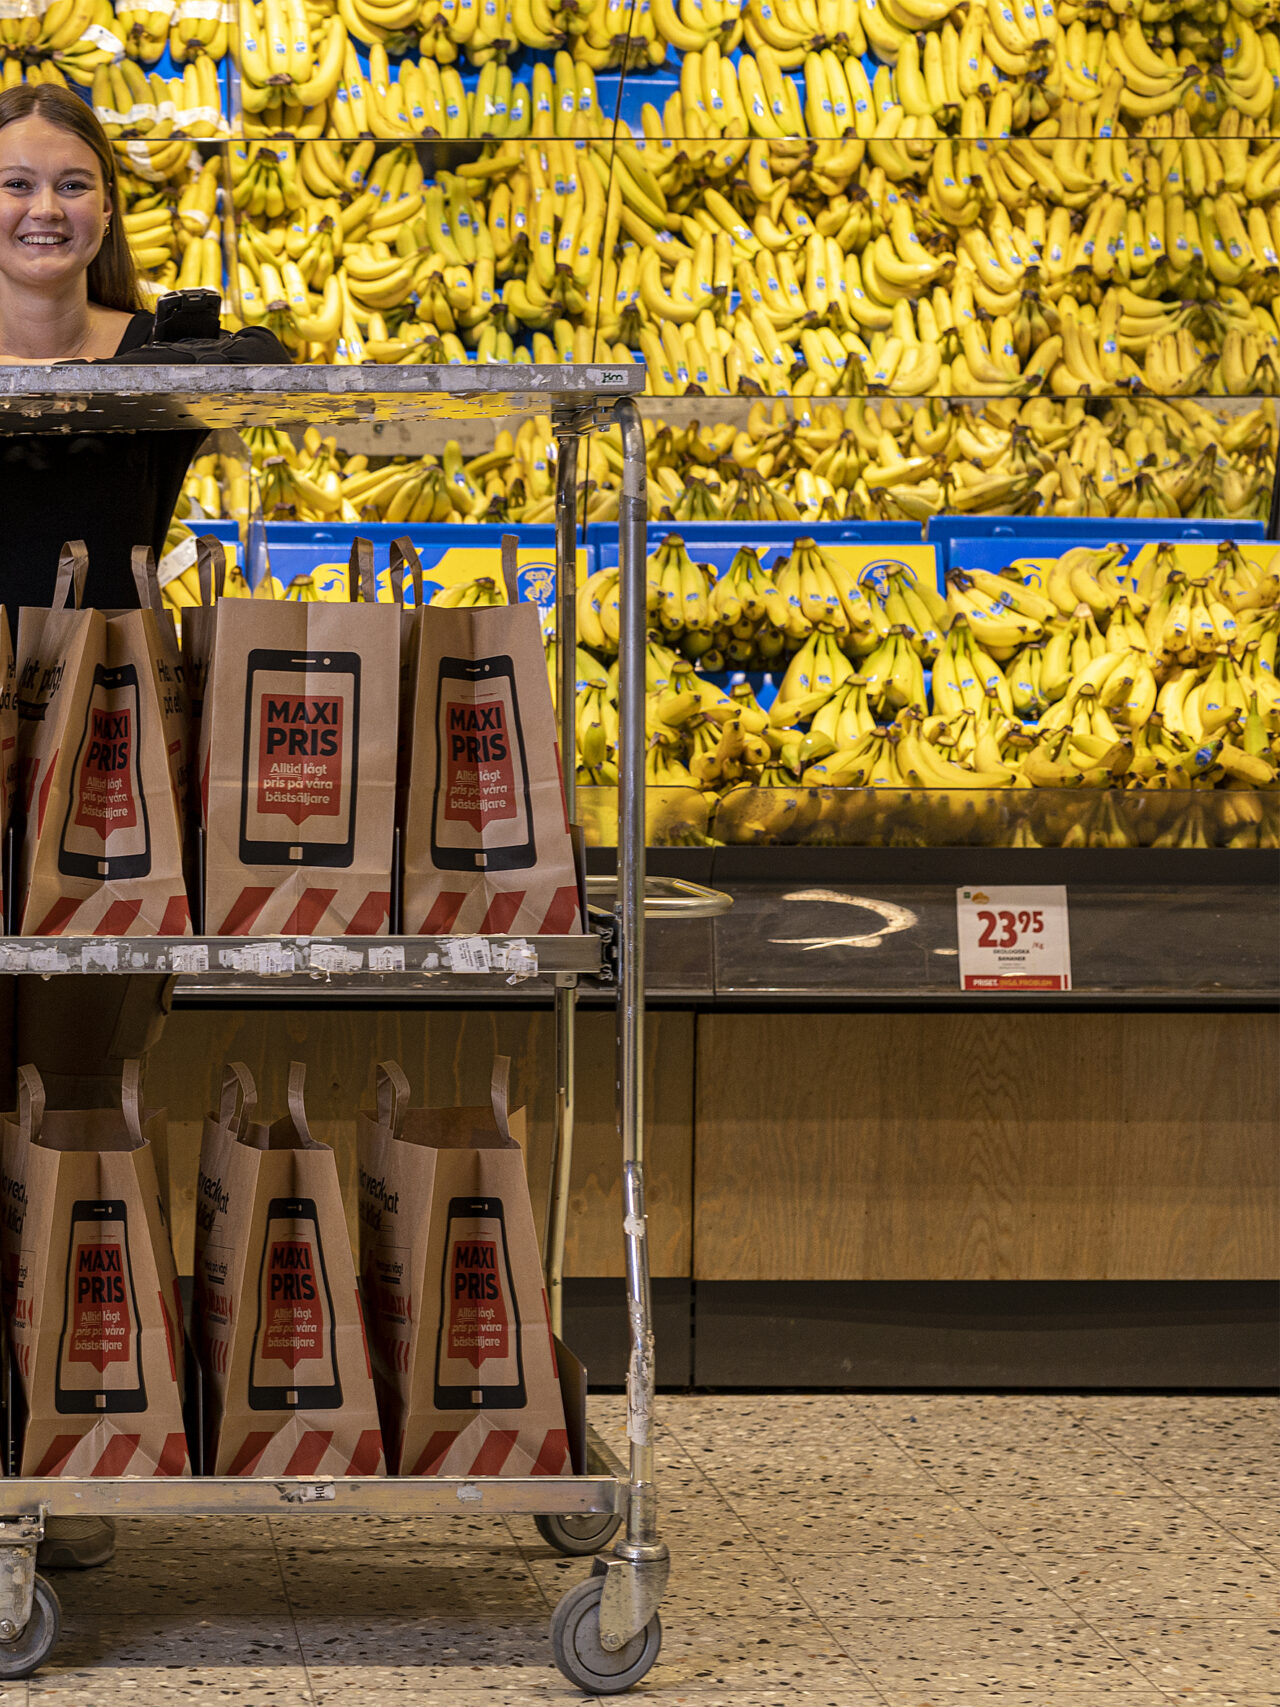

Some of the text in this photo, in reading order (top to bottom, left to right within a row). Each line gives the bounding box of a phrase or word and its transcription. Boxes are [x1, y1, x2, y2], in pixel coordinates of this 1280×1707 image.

[268, 701, 338, 724] MAXI
[450, 707, 501, 732] MAXI
[94, 715, 128, 740] MAXI
[266, 727, 338, 756] PRIS
[452, 734, 507, 763] PRIS
[86, 742, 128, 772] PRIS
[271, 762, 326, 776] Alltid lågt
[86, 776, 122, 791] Alltid lågt
[264, 776, 332, 790] pris på våra
[480, 770, 500, 783] lågt
[82, 791, 96, 802] pris
[108, 792, 127, 802] våra
[450, 785, 466, 796] pris
[483, 784, 507, 794] våra
[266, 792, 330, 805] bästsäljare
[451, 798, 506, 812] bästsäljare
[82, 806, 128, 820] bästsäljare
[78, 1250, 120, 1272] MAXI
[272, 1248, 310, 1270] MAXI
[456, 1246, 494, 1269] MAXI
[78, 1276, 124, 1304] PRIS
[272, 1273, 315, 1300] PRIS
[456, 1273, 498, 1300] PRIS
[81, 1310, 120, 1324] Alltid lågt
[293, 1308, 312, 1320] lågt
[478, 1308, 495, 1320] lågt
[75, 1324, 124, 1338] pris på våra
[268, 1324, 282, 1334] pris
[296, 1322, 316, 1332] våra
[452, 1324, 466, 1334] pris
[482, 1323, 502, 1332] våra
[75, 1340, 122, 1352] bästsäljare
[268, 1337, 315, 1349] bästsäljare
[453, 1337, 500, 1348] bästsäljare
